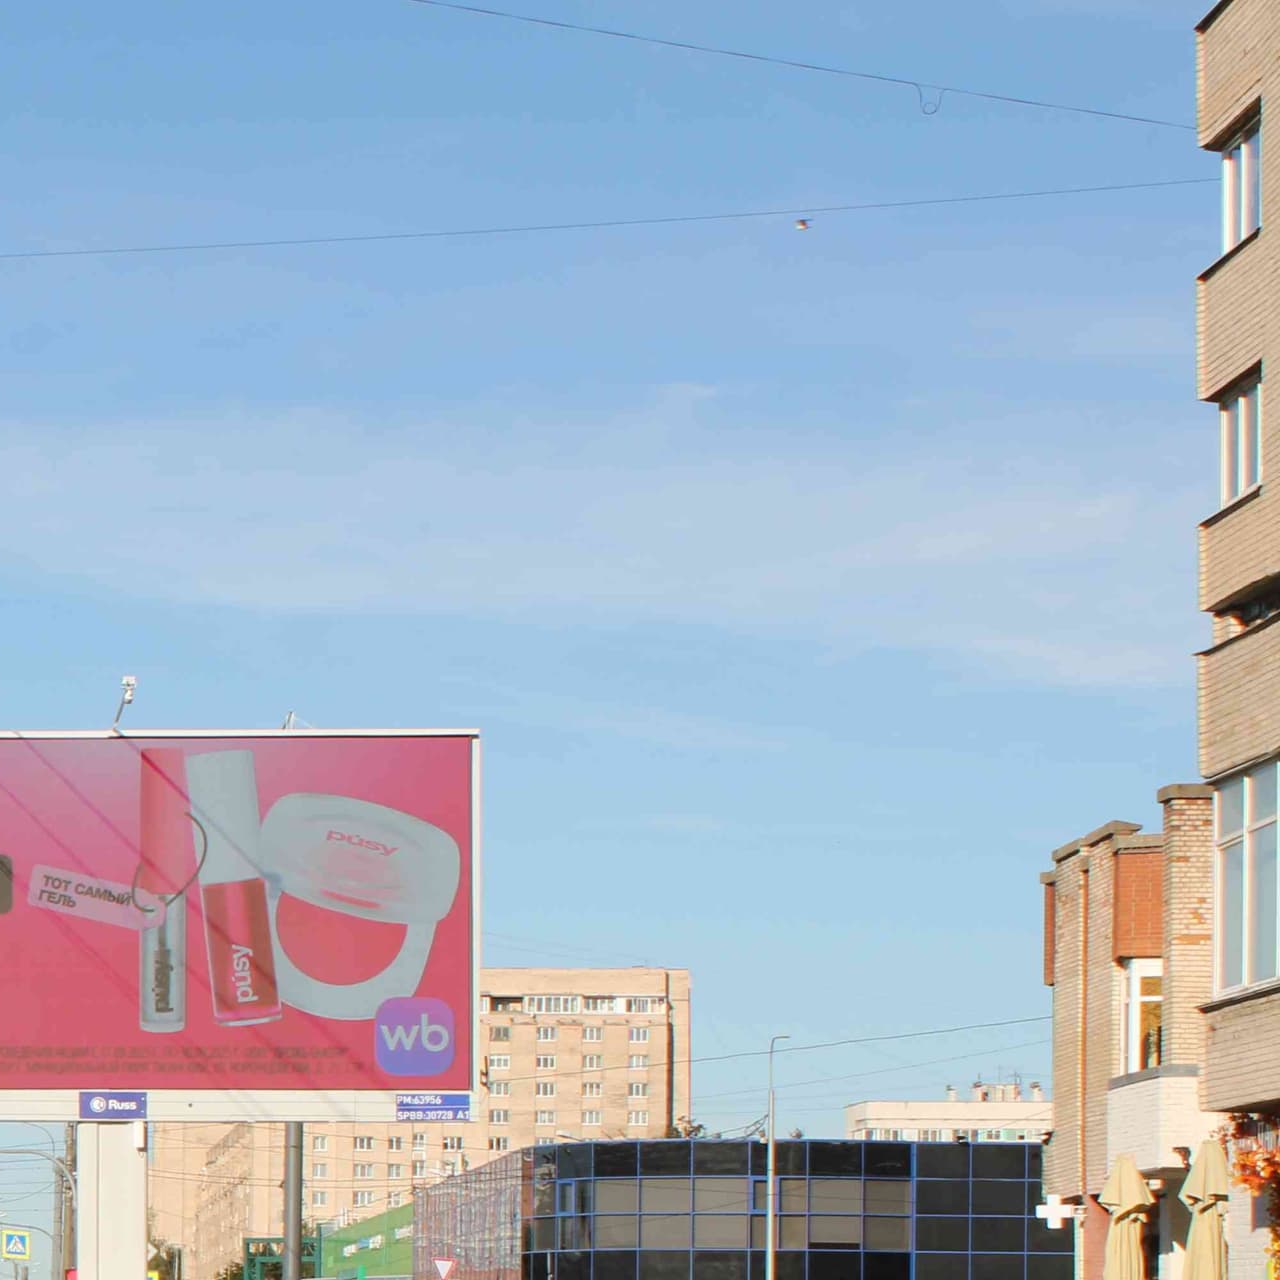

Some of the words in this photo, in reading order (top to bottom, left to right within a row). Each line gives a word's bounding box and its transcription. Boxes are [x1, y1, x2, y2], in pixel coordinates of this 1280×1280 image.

[38, 889, 77, 908] ГЕЛЬ
[43, 874, 72, 892] ТОТ
[74, 882, 133, 906] САМЫЙ
[380, 1013, 449, 1053] wb
[108, 1099, 137, 1110] Russ
